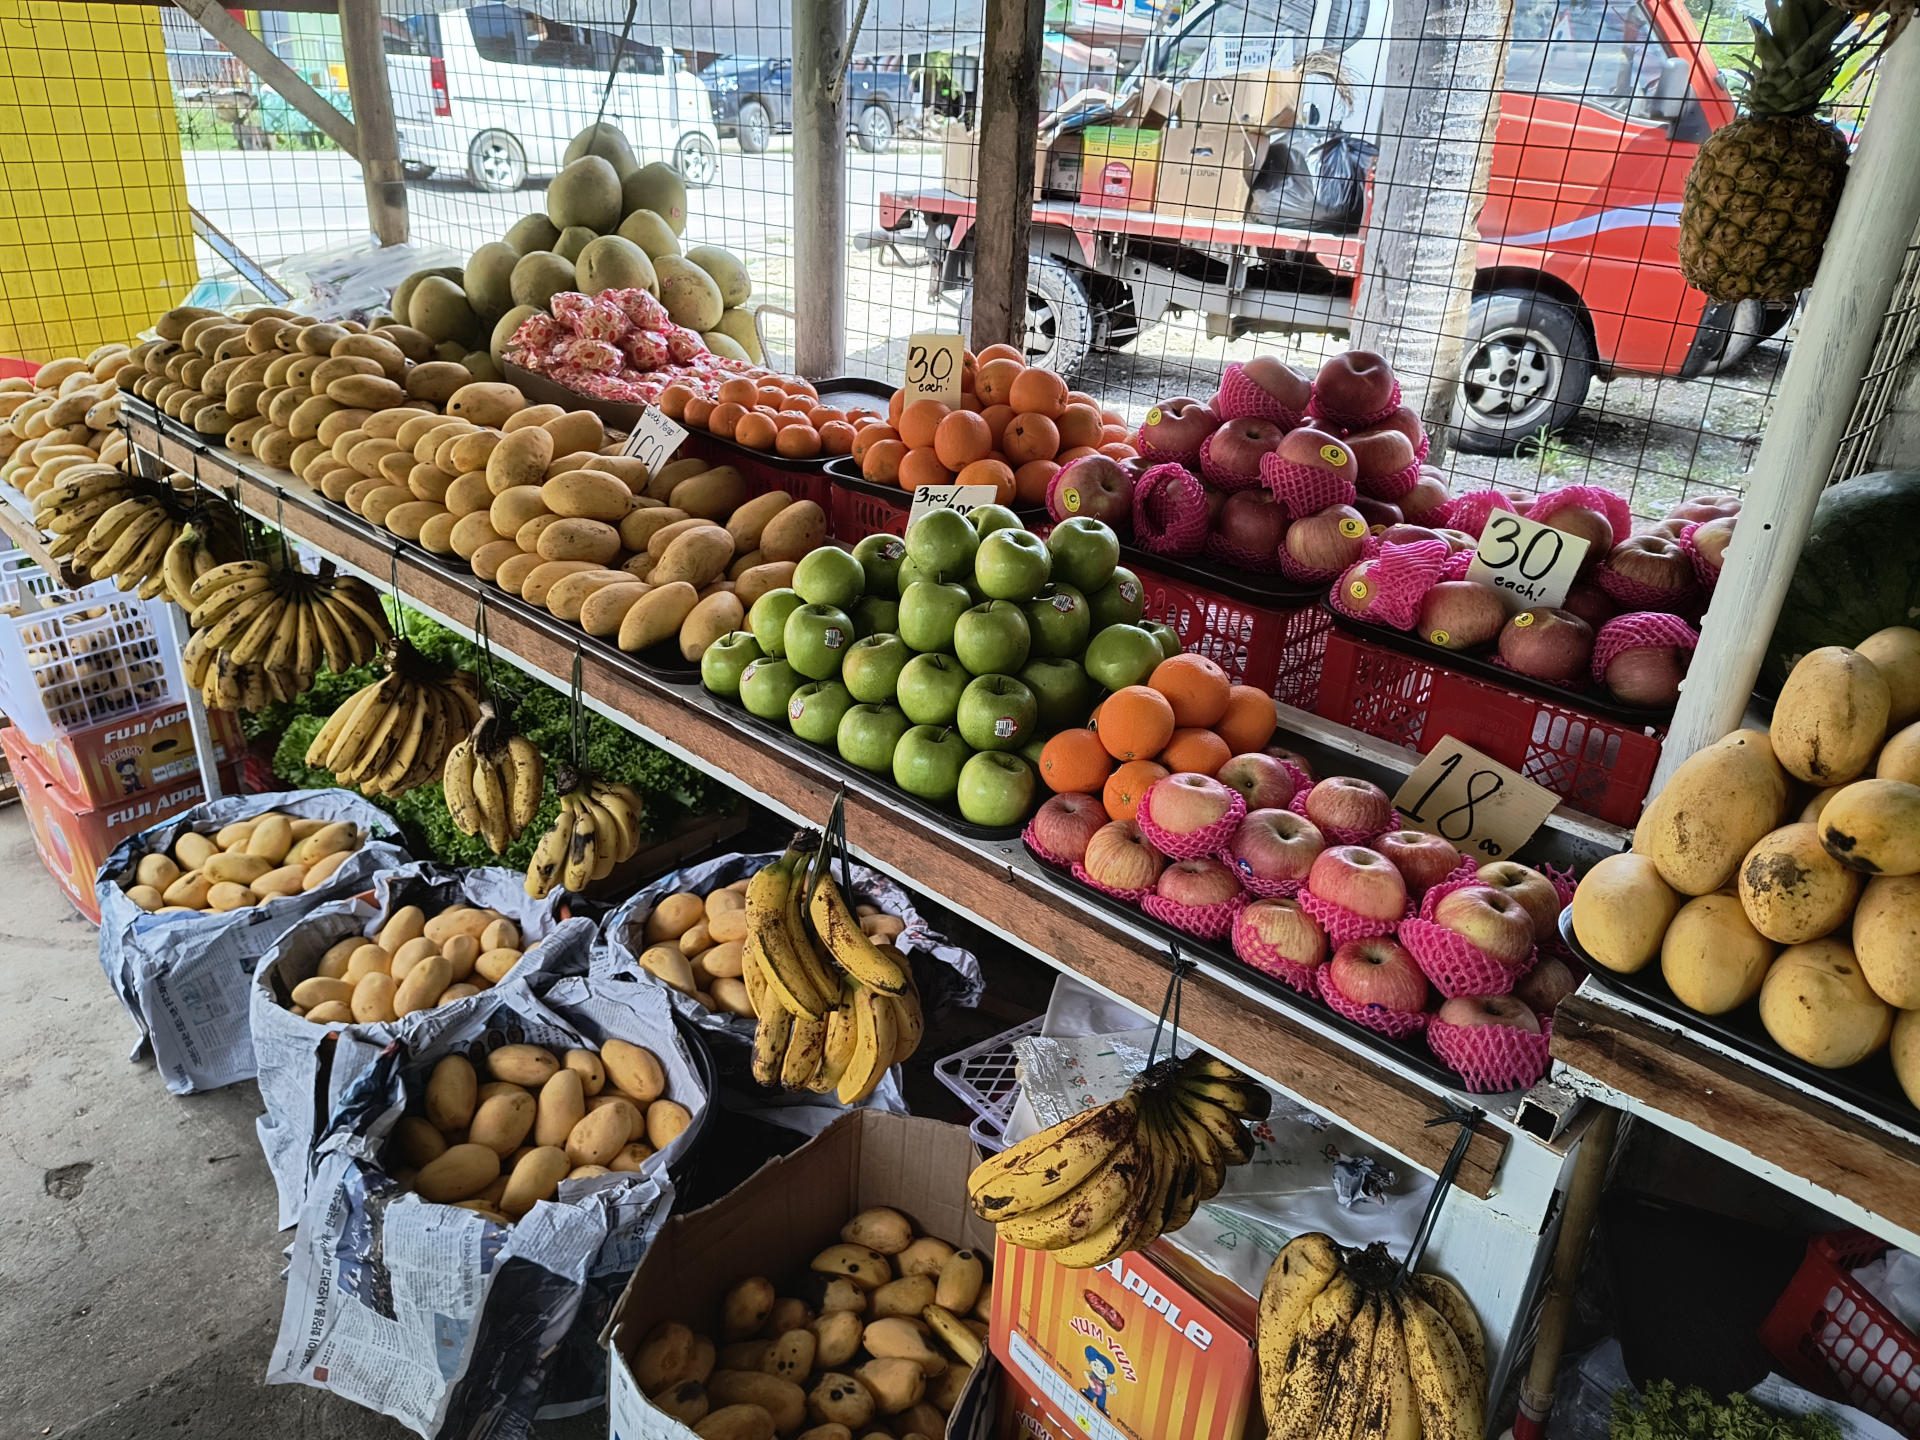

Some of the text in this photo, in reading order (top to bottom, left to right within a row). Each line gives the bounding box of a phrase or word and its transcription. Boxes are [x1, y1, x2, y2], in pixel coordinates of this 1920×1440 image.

[908, 346, 953, 384] 30
[918, 376, 950, 392] each!
[1477, 517, 1563, 580] 30
[1494, 576, 1546, 602] each!
[104, 723, 146, 744] FUJI
[101, 745, 144, 766] YUMMY
[106, 801, 152, 828] FUJI
[317, 1266, 333, 1306] 사오라고
[311, 1307, 326, 1337] 화장품
[1070, 1316, 1105, 1343] YUM
[1106, 1336, 1138, 1383] YUM
